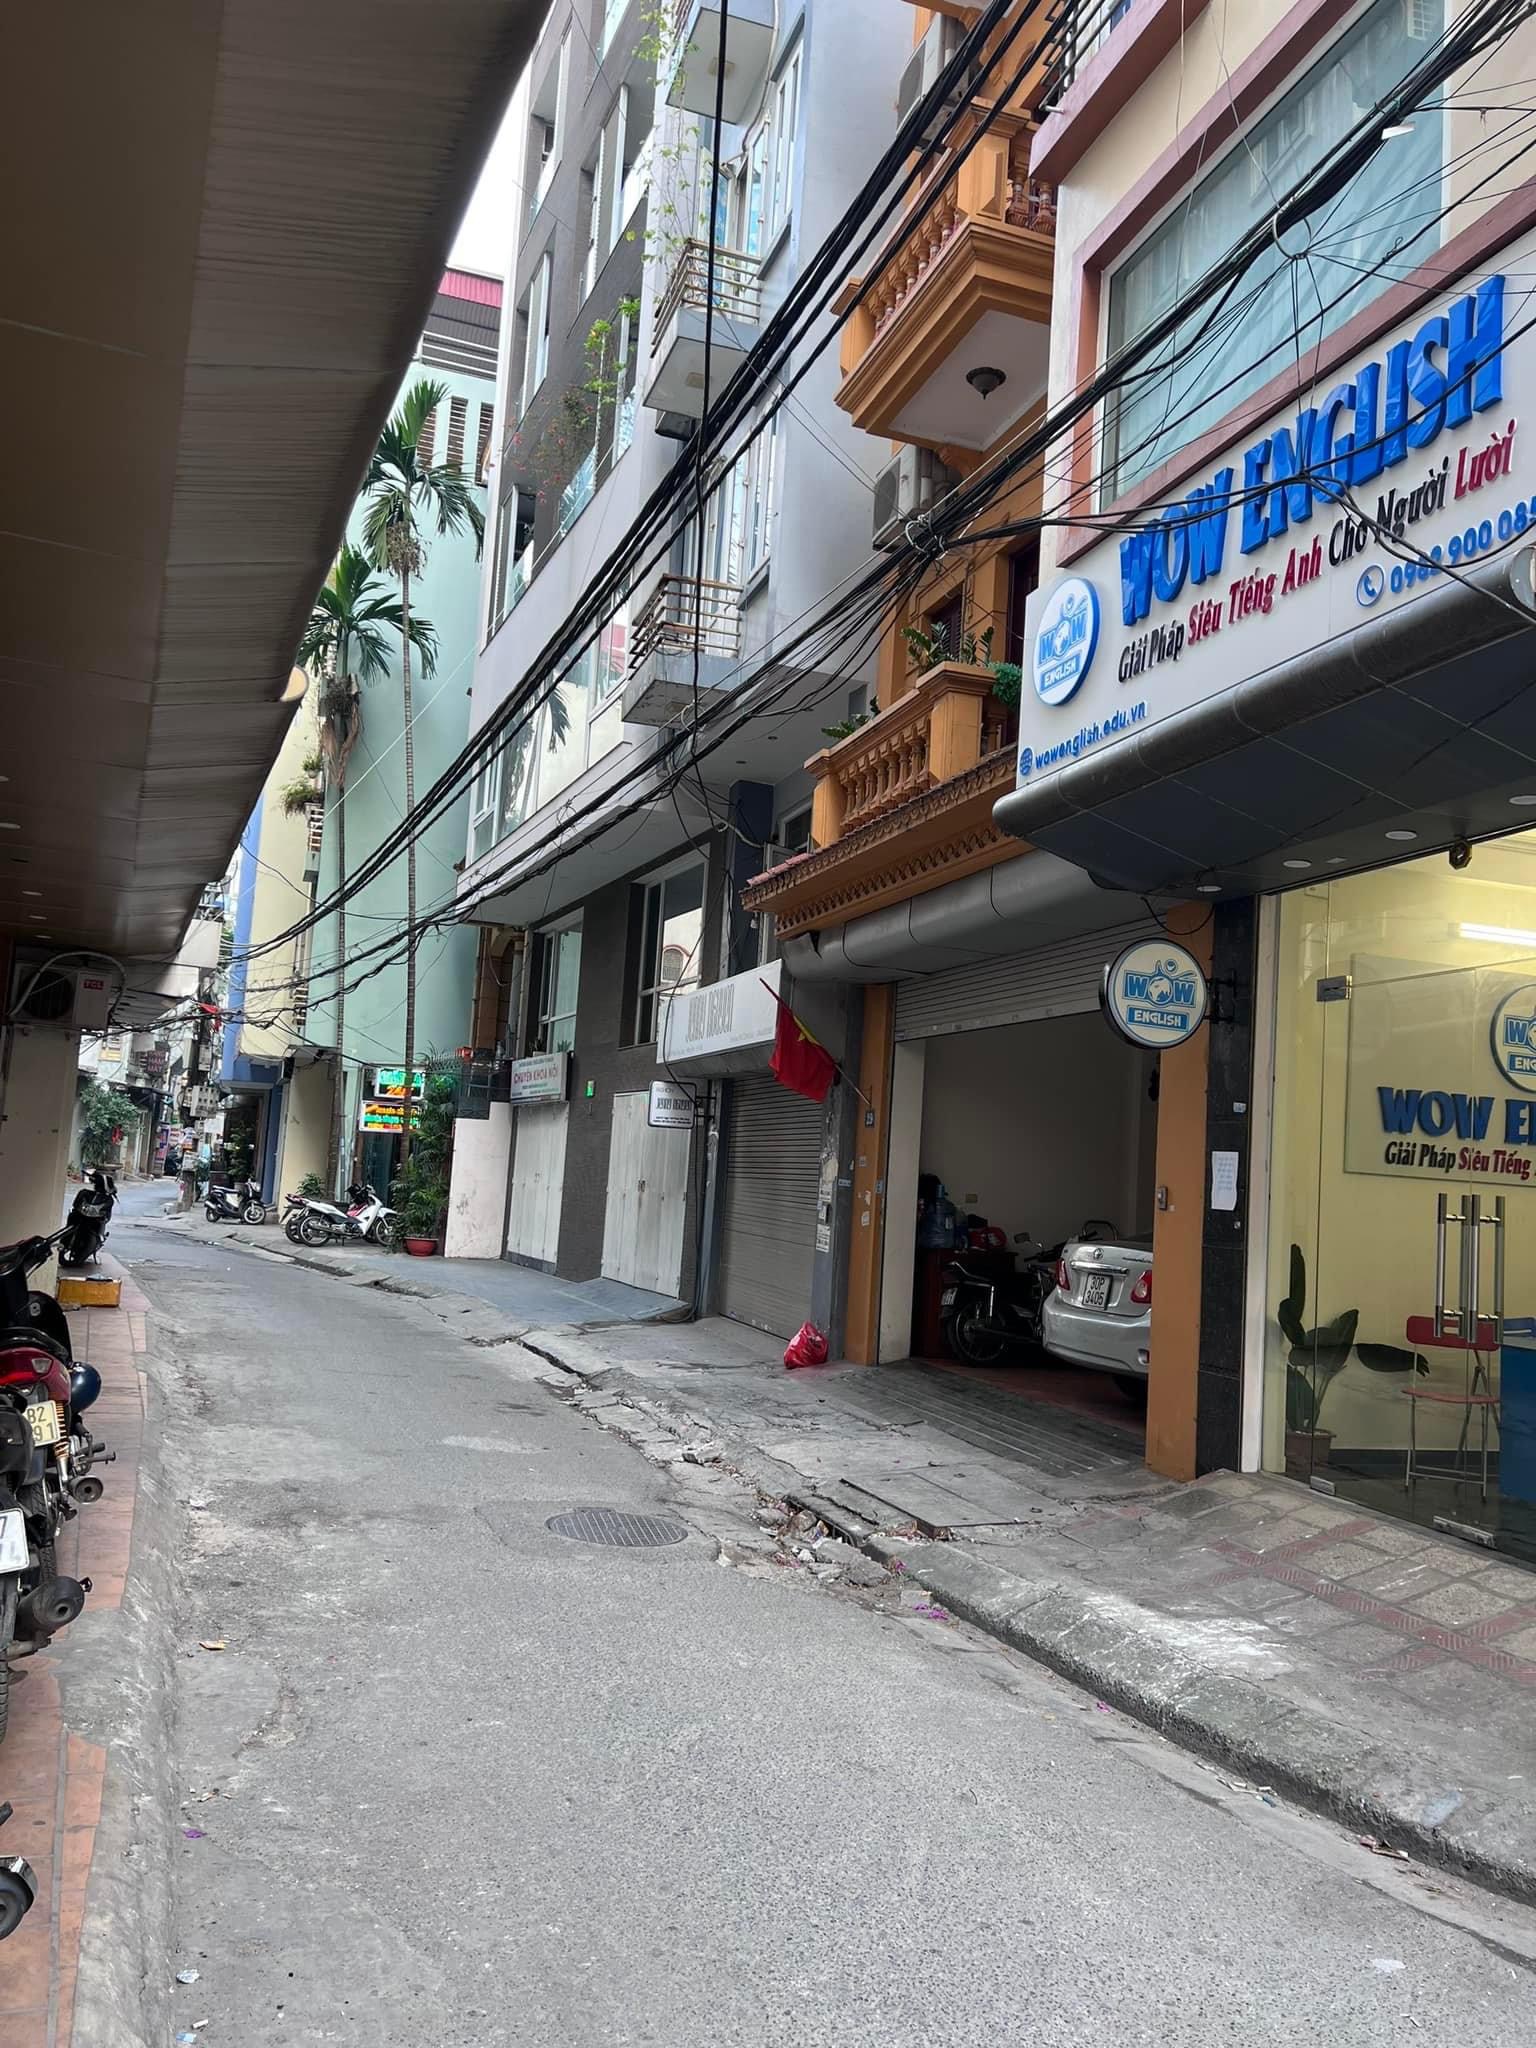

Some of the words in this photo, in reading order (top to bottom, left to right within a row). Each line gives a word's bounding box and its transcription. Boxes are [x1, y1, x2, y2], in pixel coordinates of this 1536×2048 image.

[1119, 468, 1233, 626] WOW
[1240, 274, 1505, 554] ENGLISH
[1118, 633, 1148, 682] Giải
[1148, 620, 1184, 668] Pháp
[1188, 599, 1223, 645] Siêu
[1228, 567, 1277, 624] Tiếng
[1280, 534, 1322, 595] Anh
[1329, 513, 1367, 567] Cho
[1374, 456, 1449, 543] Người
[1454, 418, 1515, 500] Lười
[1448, 519, 1492, 564] 900
[1040, 612, 1086, 665] WOW
[1043, 659, 1077, 688] ENGLISH
[1035, 701, 1146, 769] wowenglish.edu.vn
[1126, 973, 1195, 1005] WOW
[1134, 1009, 1182, 1027] ENGLISH
[1377, 1087, 1495, 1142] WOW
[1385, 1141, 1417, 1166] Giải
[1418, 1143, 1456, 1173] Pháp
[1458, 1147, 1489, 1172] Siêu
[1491, 1149, 1533, 1181] Tiếng
